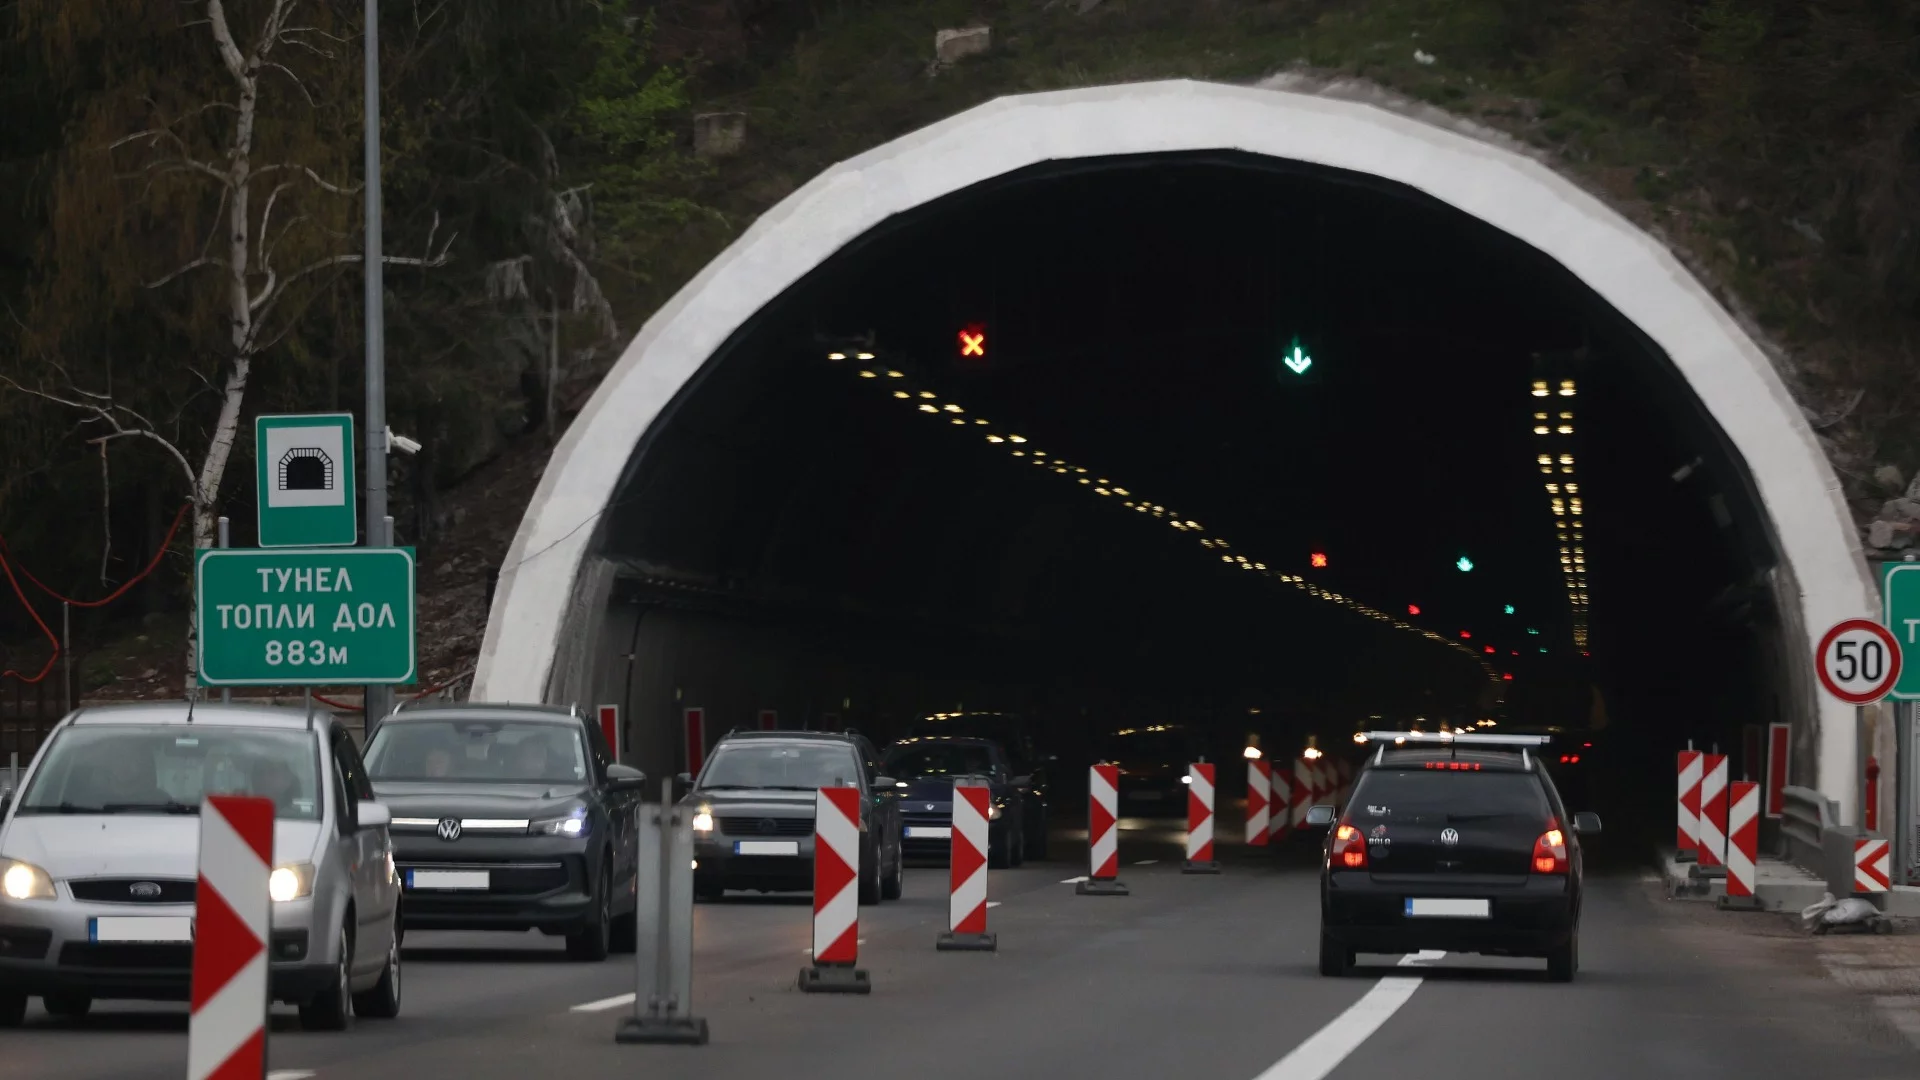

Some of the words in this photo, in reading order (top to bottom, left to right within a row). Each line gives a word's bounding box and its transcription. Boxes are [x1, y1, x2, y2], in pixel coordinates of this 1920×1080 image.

[257, 567, 352, 592] ТУНЕЛ
[217, 603, 315, 629] ТОПЛИ
[333, 602, 395, 632] ДОЛ
[265, 640, 348, 665] 883м
[1836, 640, 1882, 682] 50
